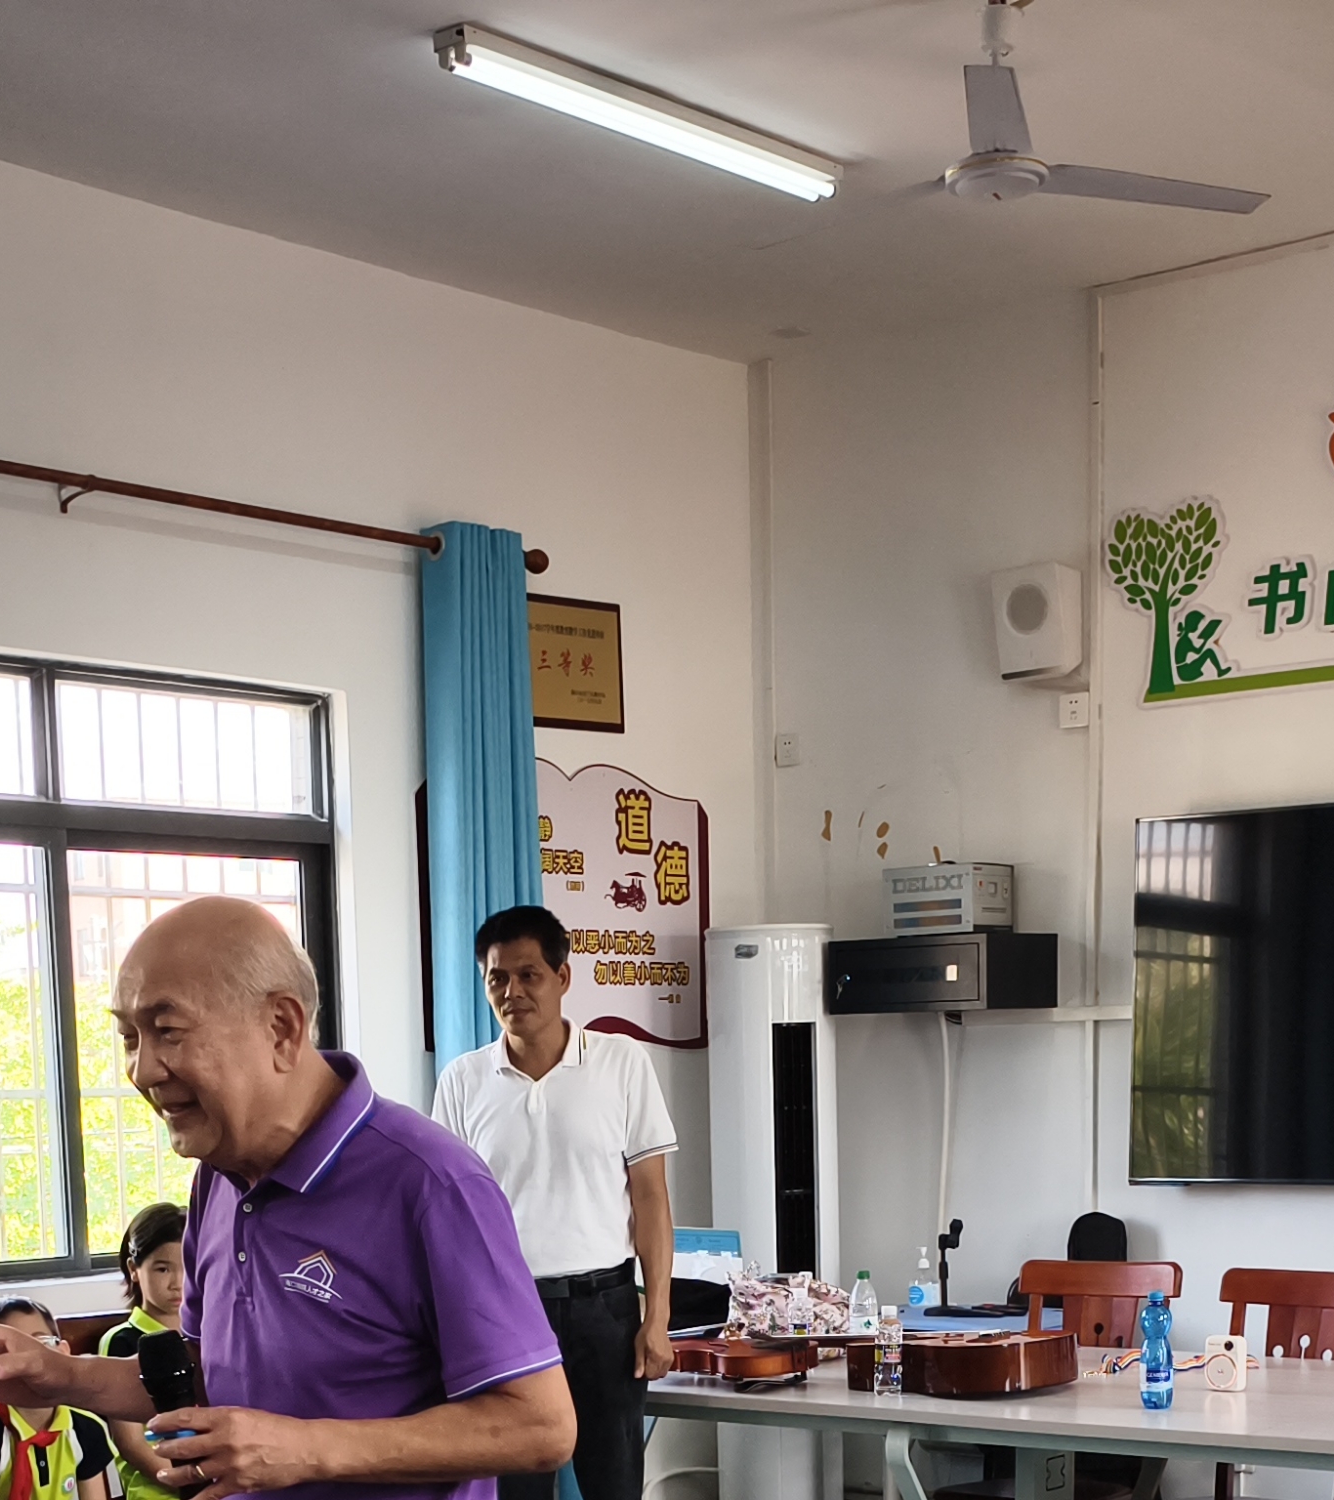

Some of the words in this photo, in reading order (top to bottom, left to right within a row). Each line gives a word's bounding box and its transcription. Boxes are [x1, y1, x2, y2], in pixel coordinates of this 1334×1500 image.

[537, 648, 595, 678] 三等奖
[615, 788, 690, 905] 道德
[565, 929, 656, 955] 以恶小而为之
[594, 960, 690, 986] 勿以善小而不为
